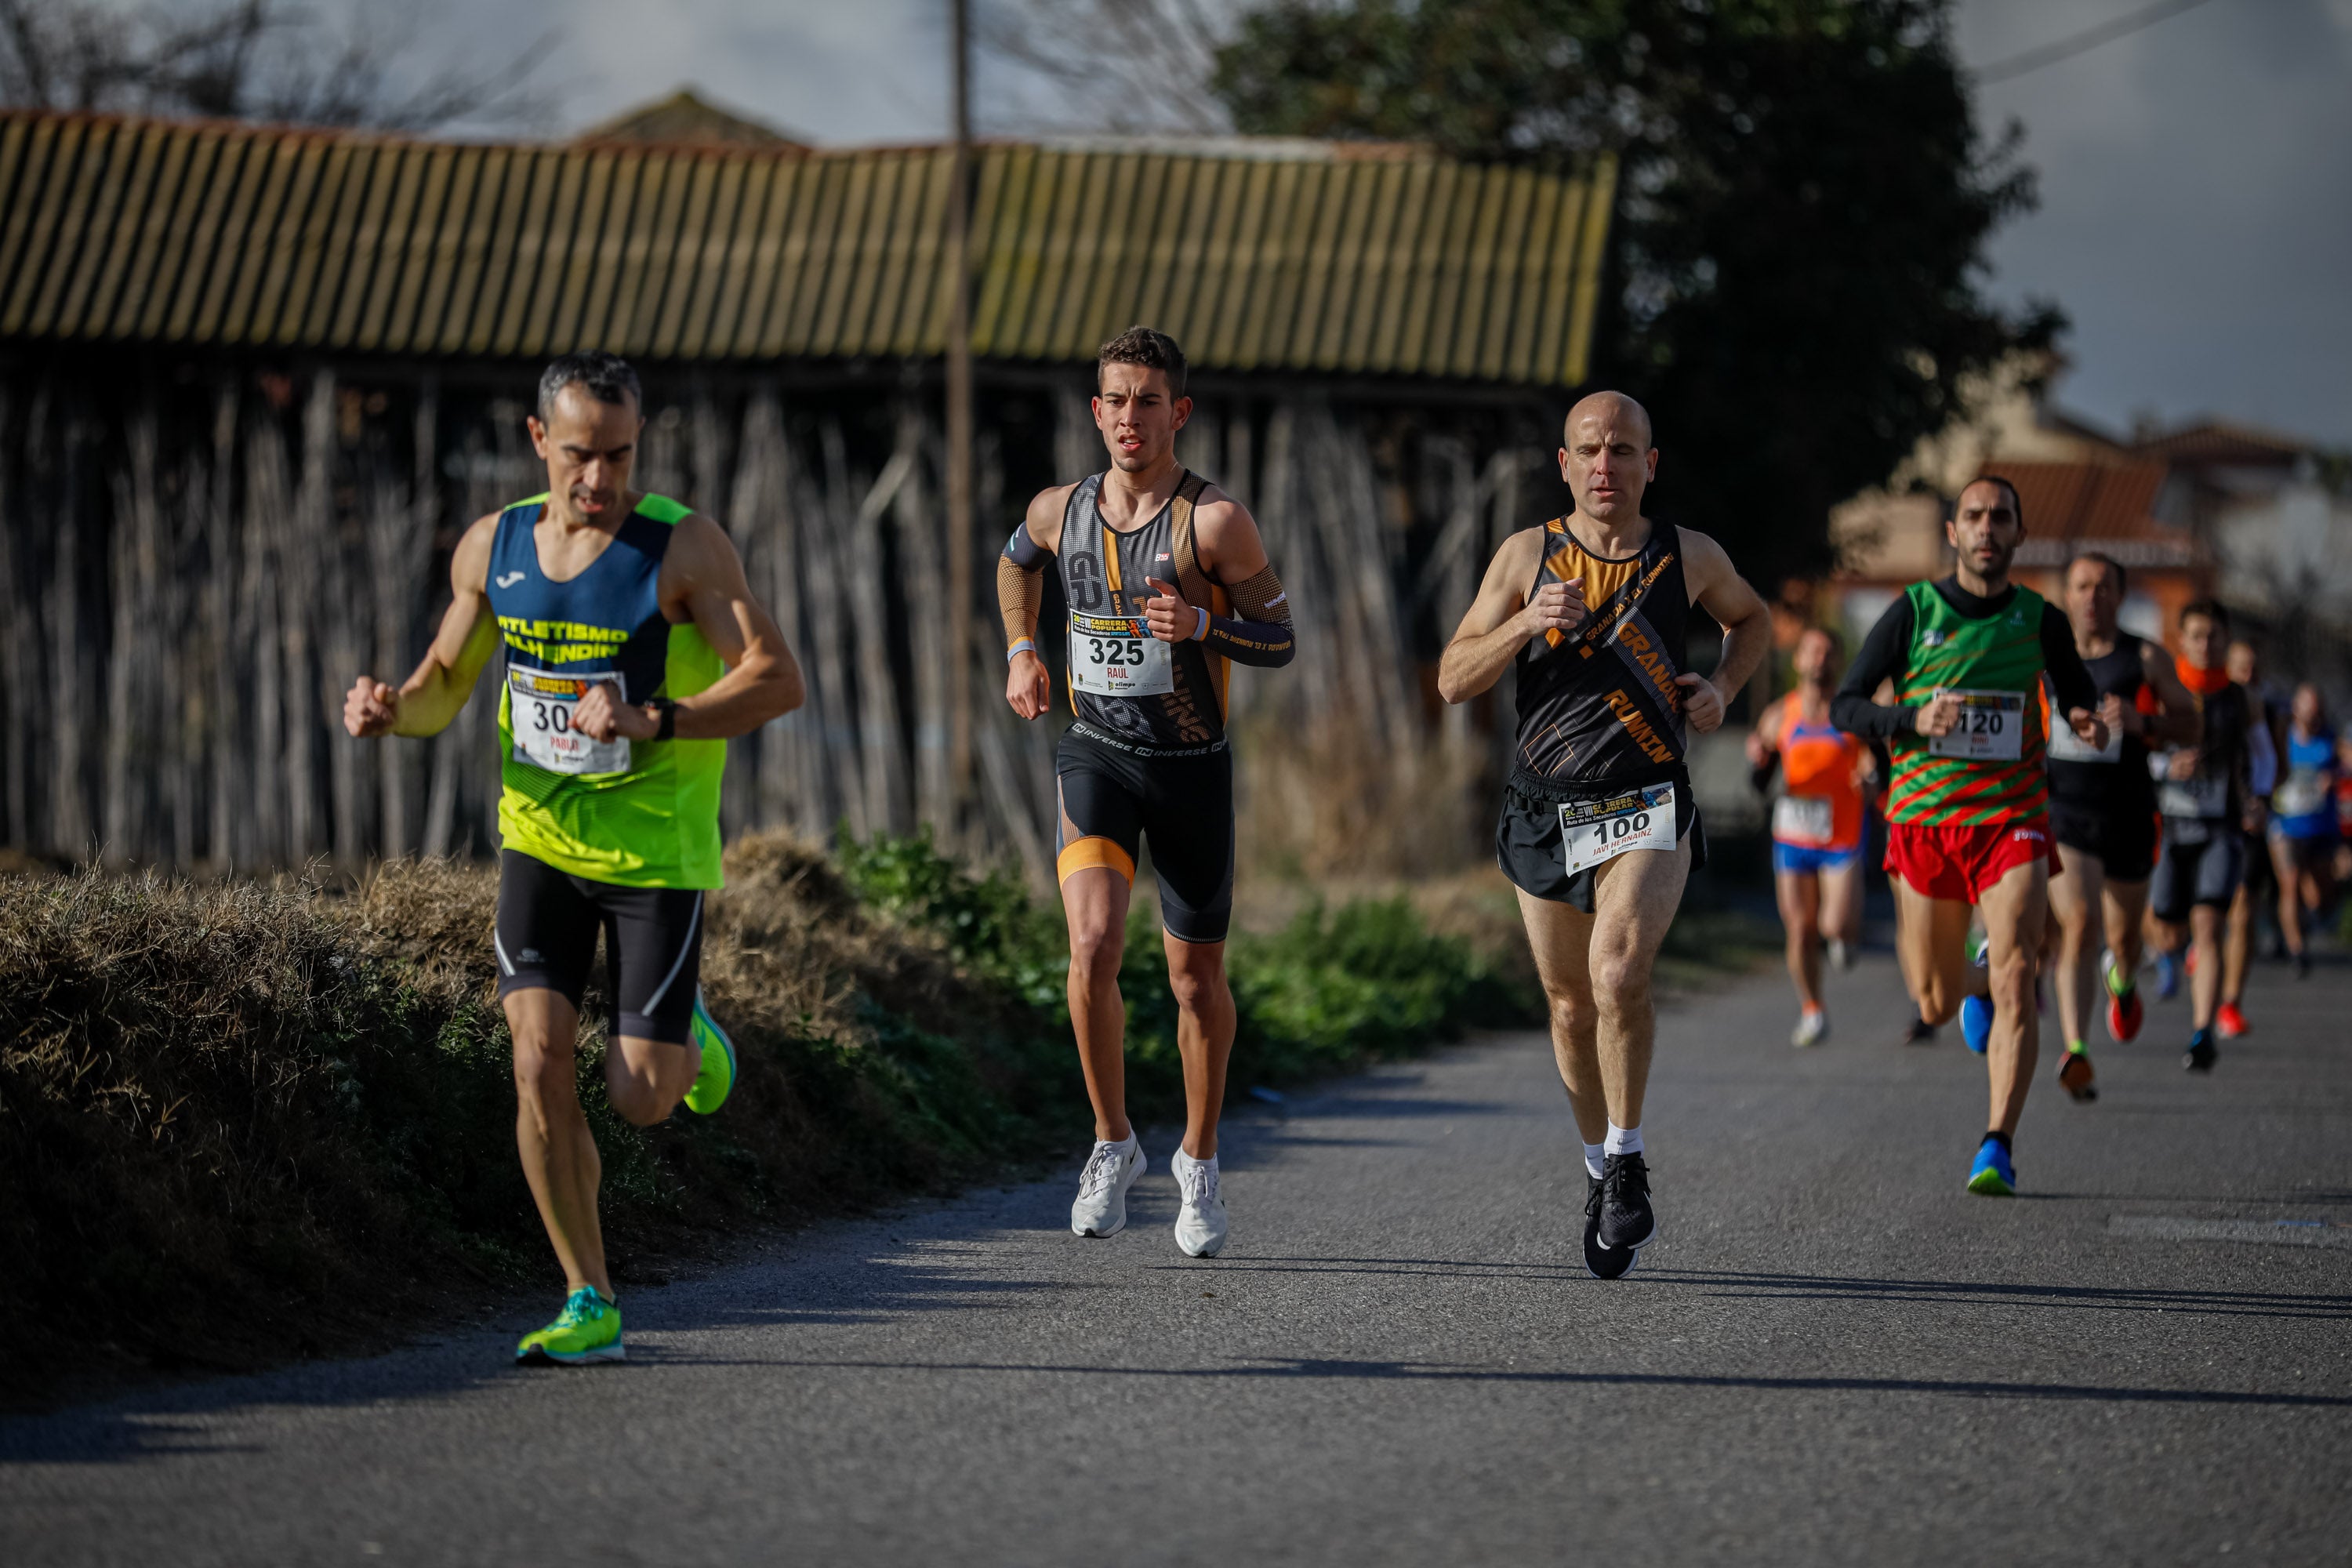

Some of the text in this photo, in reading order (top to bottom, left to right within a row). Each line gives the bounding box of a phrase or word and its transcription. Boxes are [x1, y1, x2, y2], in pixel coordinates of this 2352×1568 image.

[1113, 593, 1123, 616] GRAN
[1586, 603, 1626, 641] GRANADA
[1641, 552, 1675, 589] RUNNING
[498, 615, 629, 643] ATLETISMO
[1089, 638, 1145, 666] 325
[1107, 666, 1129, 679] RAÚL
[534, 702, 586, 735] 30
[1602, 688, 1675, 764] RUNNIN
[1961, 713, 2004, 735] 120
[1083, 729, 1133, 751] INVERSE
[1154, 747, 1209, 757] INVERSE
[1584, 805, 1594, 817] VII
[1592, 812, 1617, 821] Secaderos
[1592, 844, 1610, 857] JAVI
[1611, 828, 1653, 848] HERNAINZ
[1594, 813, 1650, 845] 100
